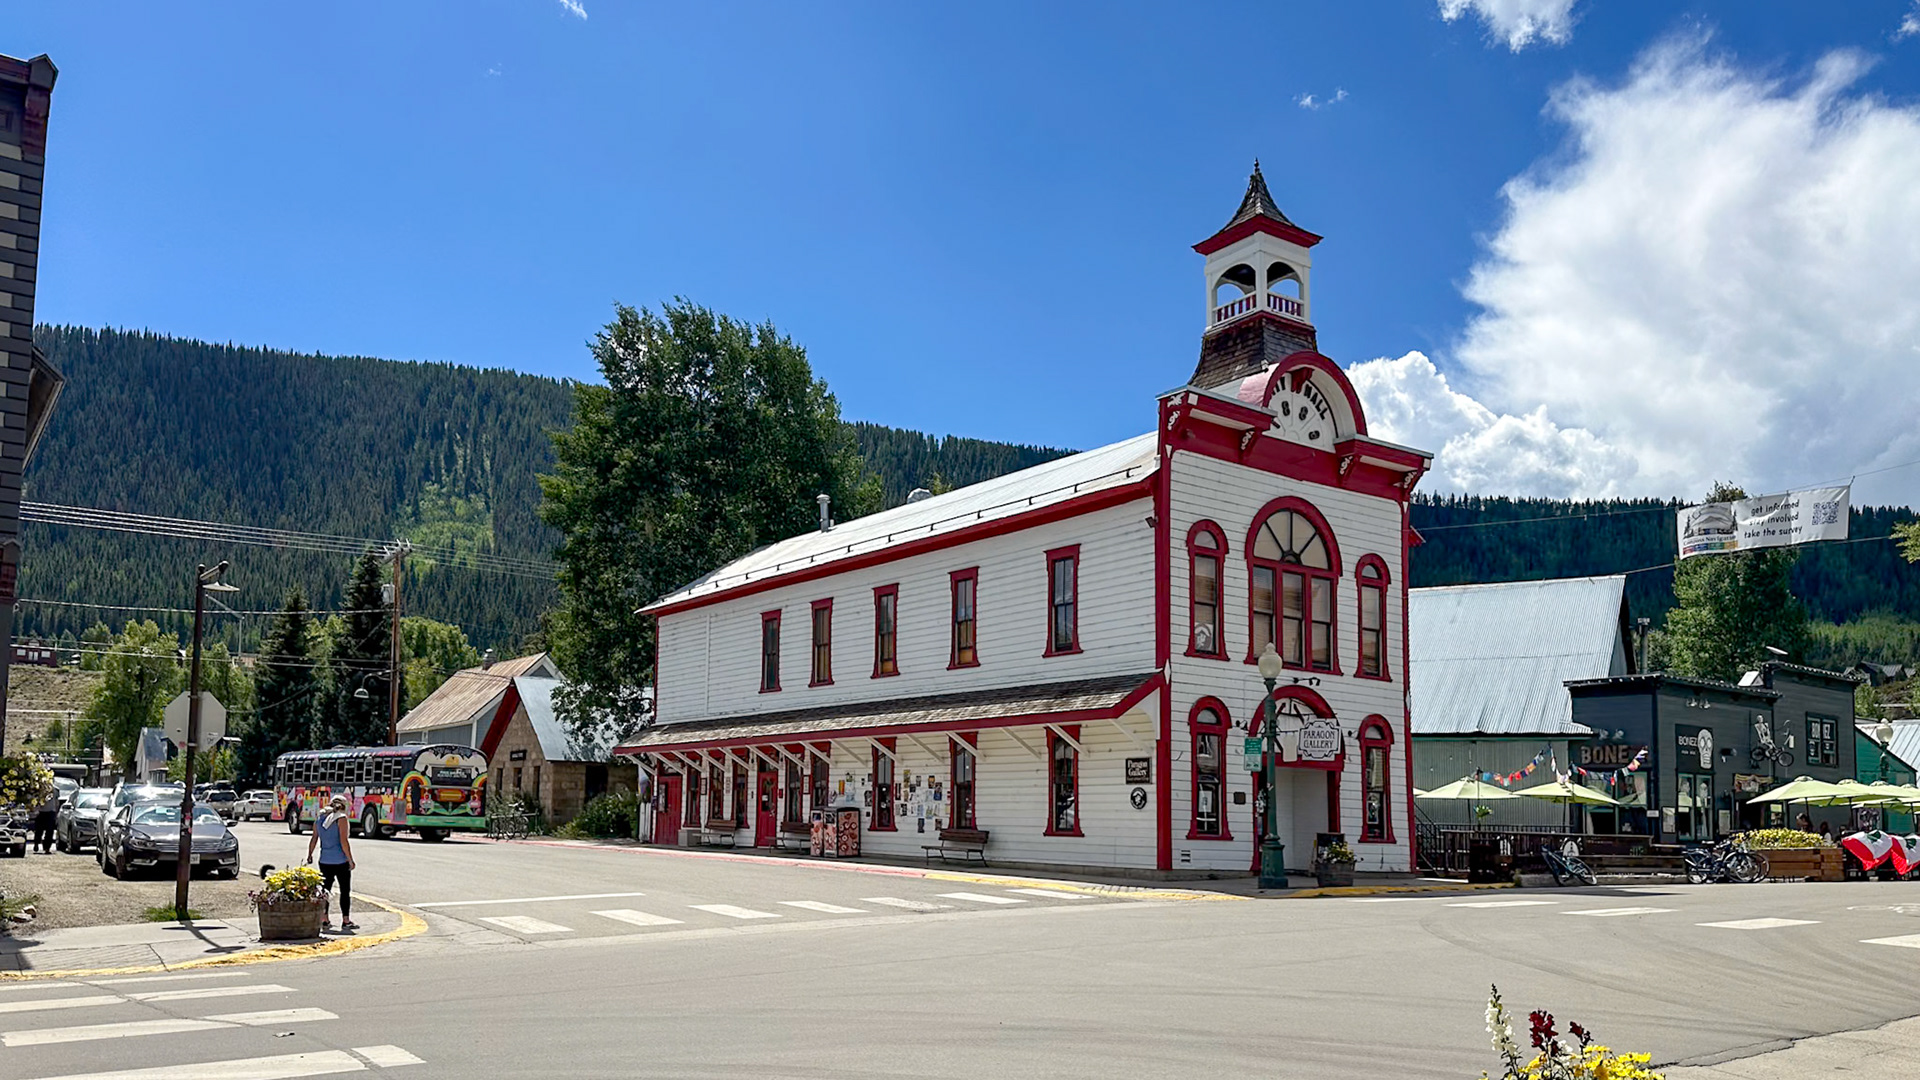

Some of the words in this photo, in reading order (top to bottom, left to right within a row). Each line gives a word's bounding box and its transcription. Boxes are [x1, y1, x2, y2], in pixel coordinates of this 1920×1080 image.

[1304, 384, 1328, 420] HALL
[1751, 505, 1763, 517] get
[1766, 499, 1800, 513] informed
[1767, 512, 1799, 524] involved
[1744, 529, 1761, 539] take
[1763, 527, 1777, 537] the
[1779, 525, 1803, 536] survey
[1303, 730, 1336, 739] PARAGON
[1303, 739, 1334, 749] GALLERY
[1581, 744, 1630, 765] BONE
[1127, 759, 1148, 769] Paragon
[1128, 767, 1148, 777] Gallery
